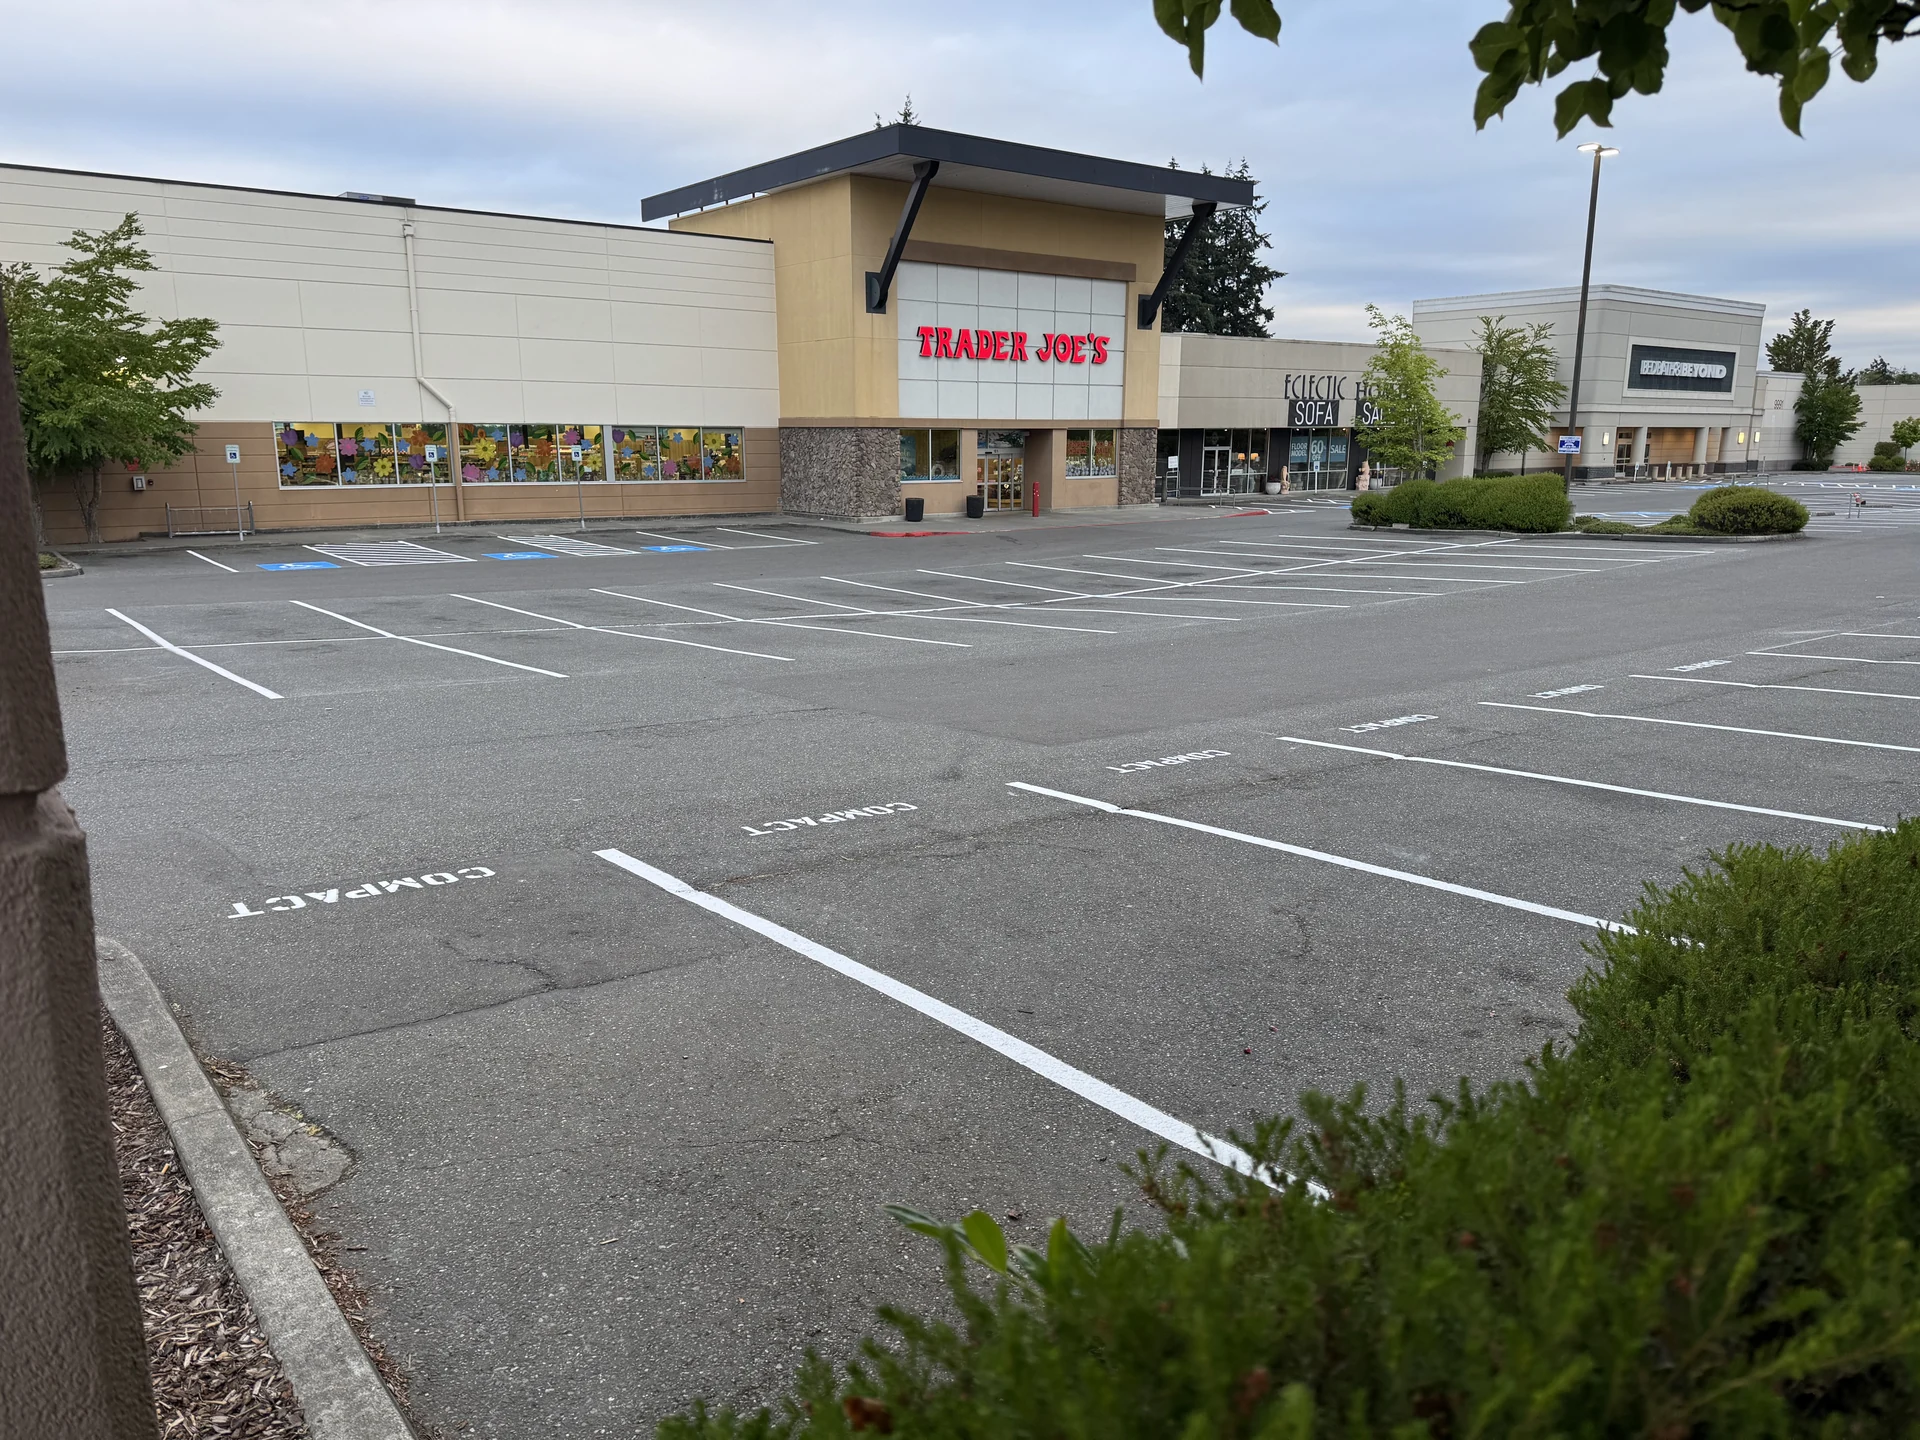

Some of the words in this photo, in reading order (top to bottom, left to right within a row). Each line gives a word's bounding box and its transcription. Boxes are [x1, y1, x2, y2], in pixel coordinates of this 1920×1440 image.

[917, 326, 1029, 361] TRADER
[1036, 332, 1110, 364] JOE'S
[1284, 374, 1347, 400] ECLECTIC
[1295, 401, 1334, 425] SOFA
[1330, 445, 1347, 454] SALE
[740, 802, 919, 837] COMPACT
[227, 866, 496, 919] COMPACT
